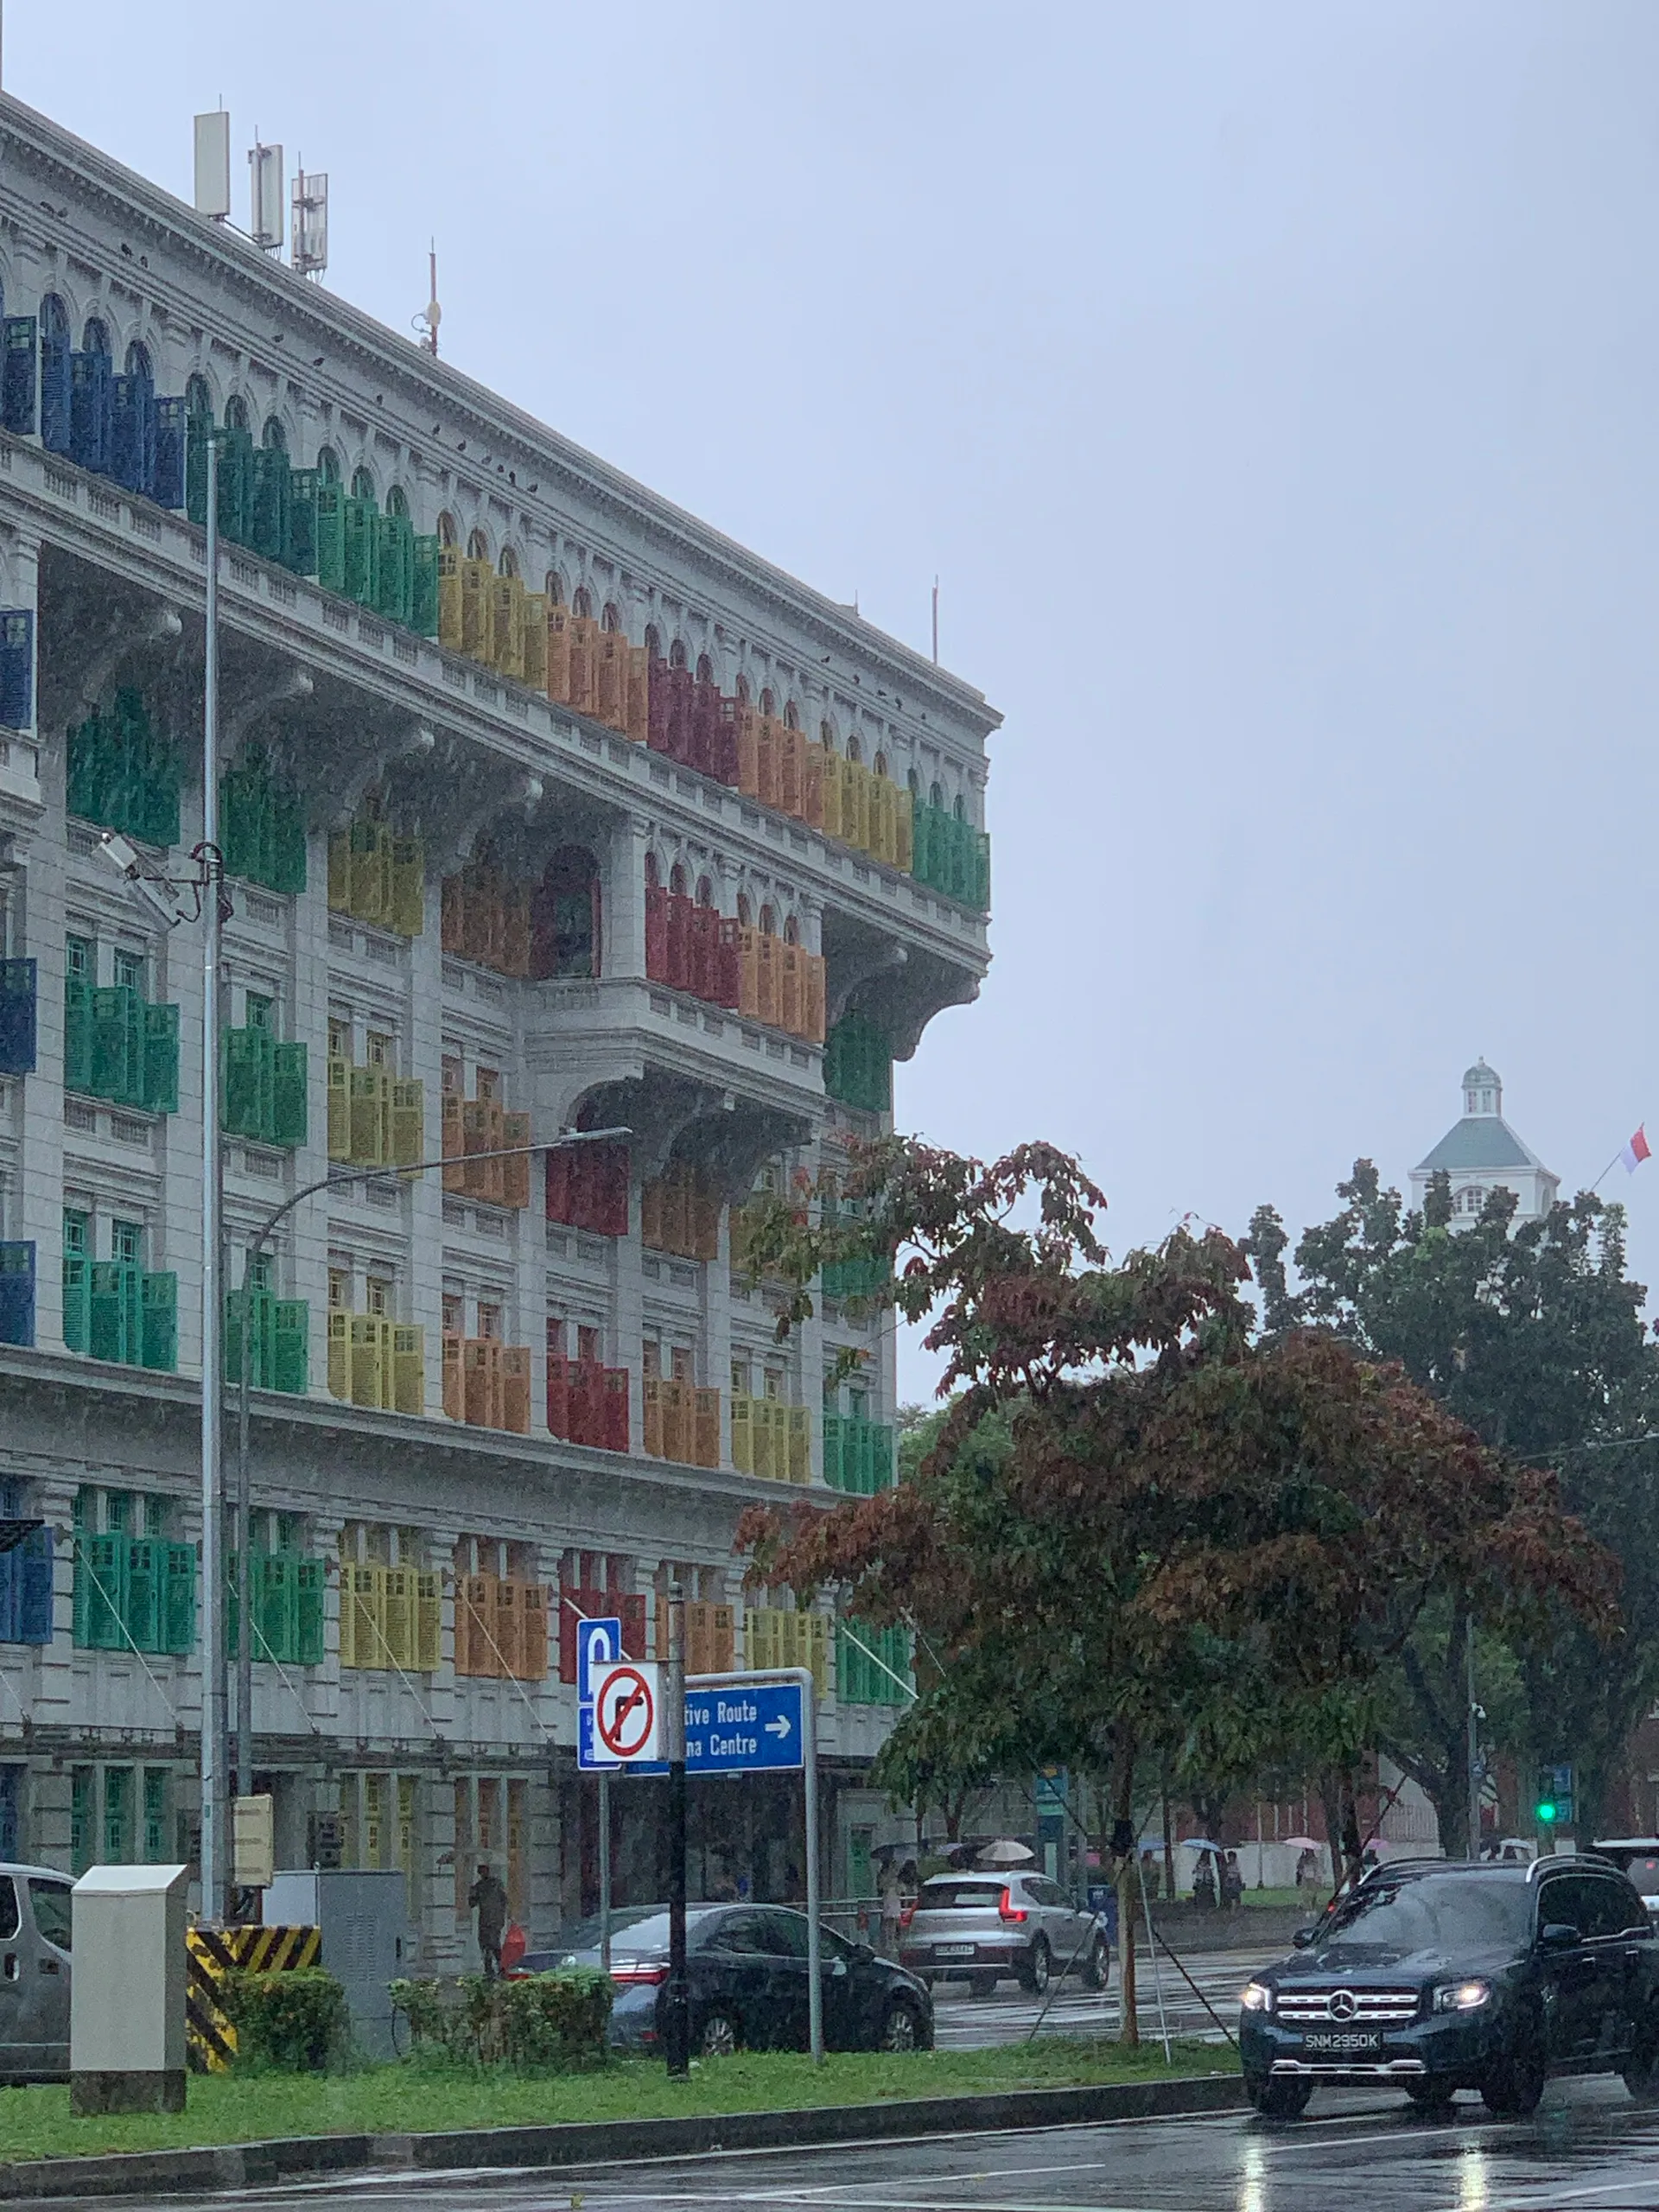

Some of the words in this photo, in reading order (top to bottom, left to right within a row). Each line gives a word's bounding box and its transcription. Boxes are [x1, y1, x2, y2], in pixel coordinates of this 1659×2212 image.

[683, 1703, 709, 1726] tive
[717, 1700, 758, 1723] Route
[686, 1740, 702, 1758] na
[709, 1732, 758, 1756] Centre
[1305, 2034, 1378, 2048] SNM2950K
